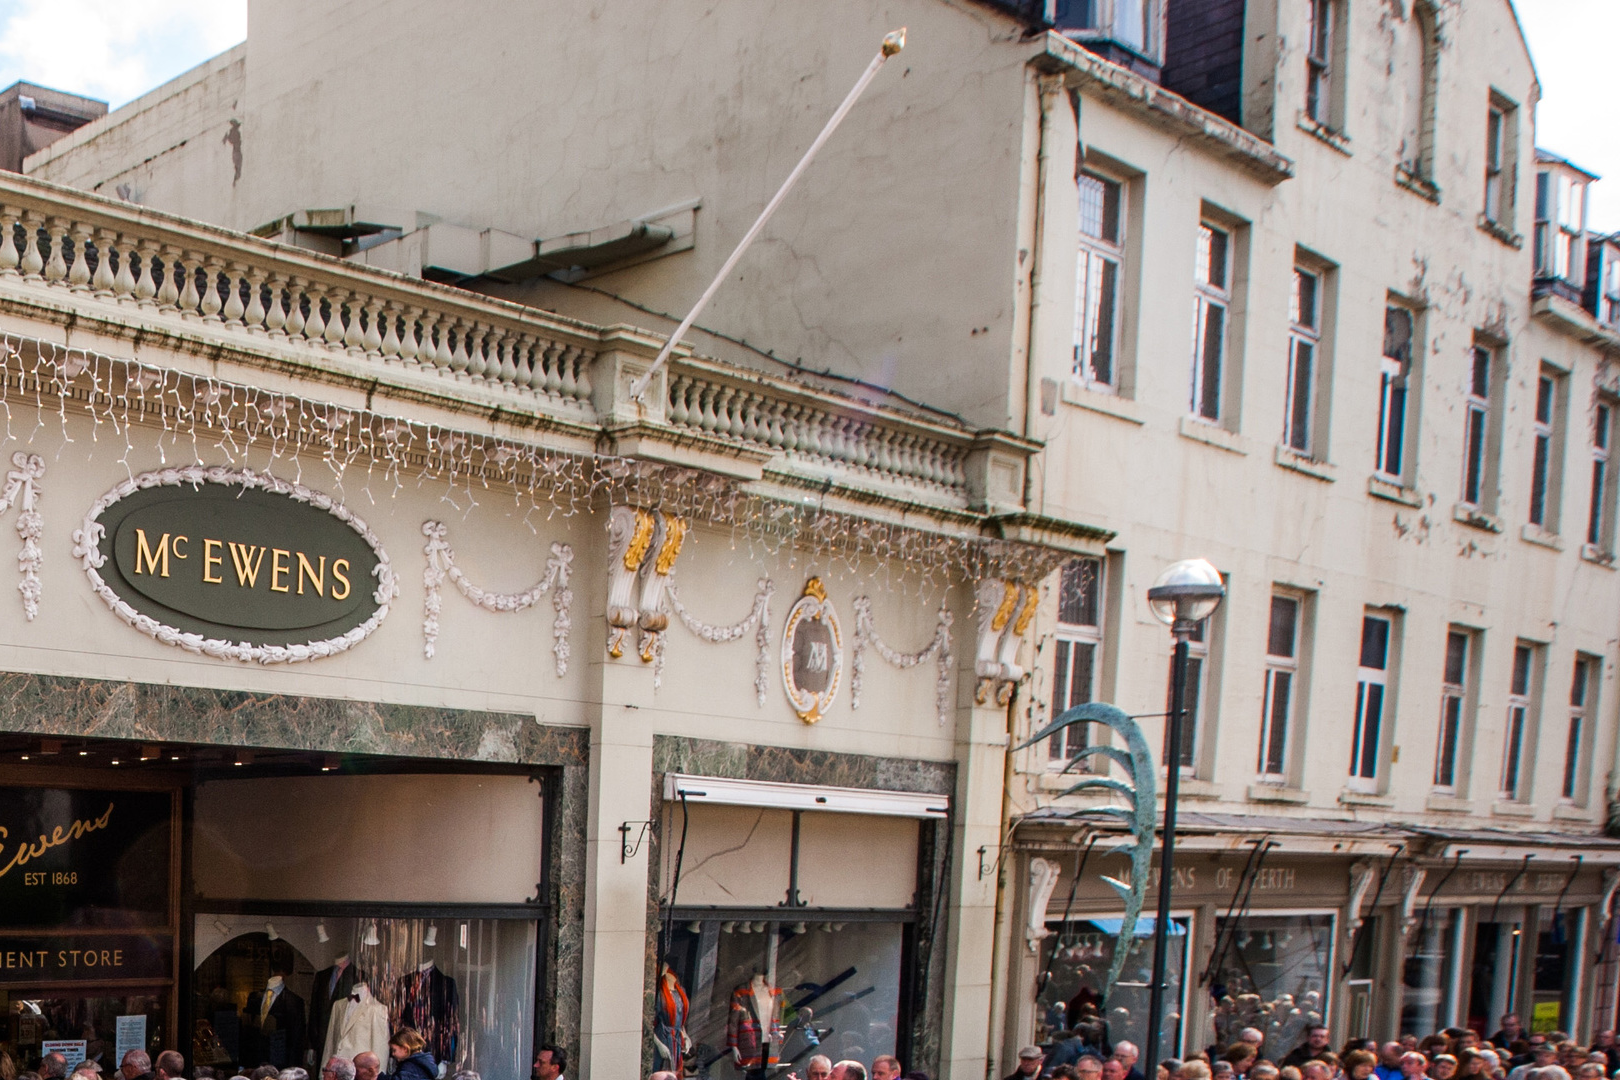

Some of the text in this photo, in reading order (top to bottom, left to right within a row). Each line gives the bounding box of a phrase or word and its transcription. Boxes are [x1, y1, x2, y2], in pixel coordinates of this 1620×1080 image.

[202, 538, 352, 601] EWENS
[24, 871, 78, 886] EST 1868
[1216, 867, 1234, 889] OF
[1251, 867, 1296, 889] PERTH
[57, 949, 124, 968] STORE
